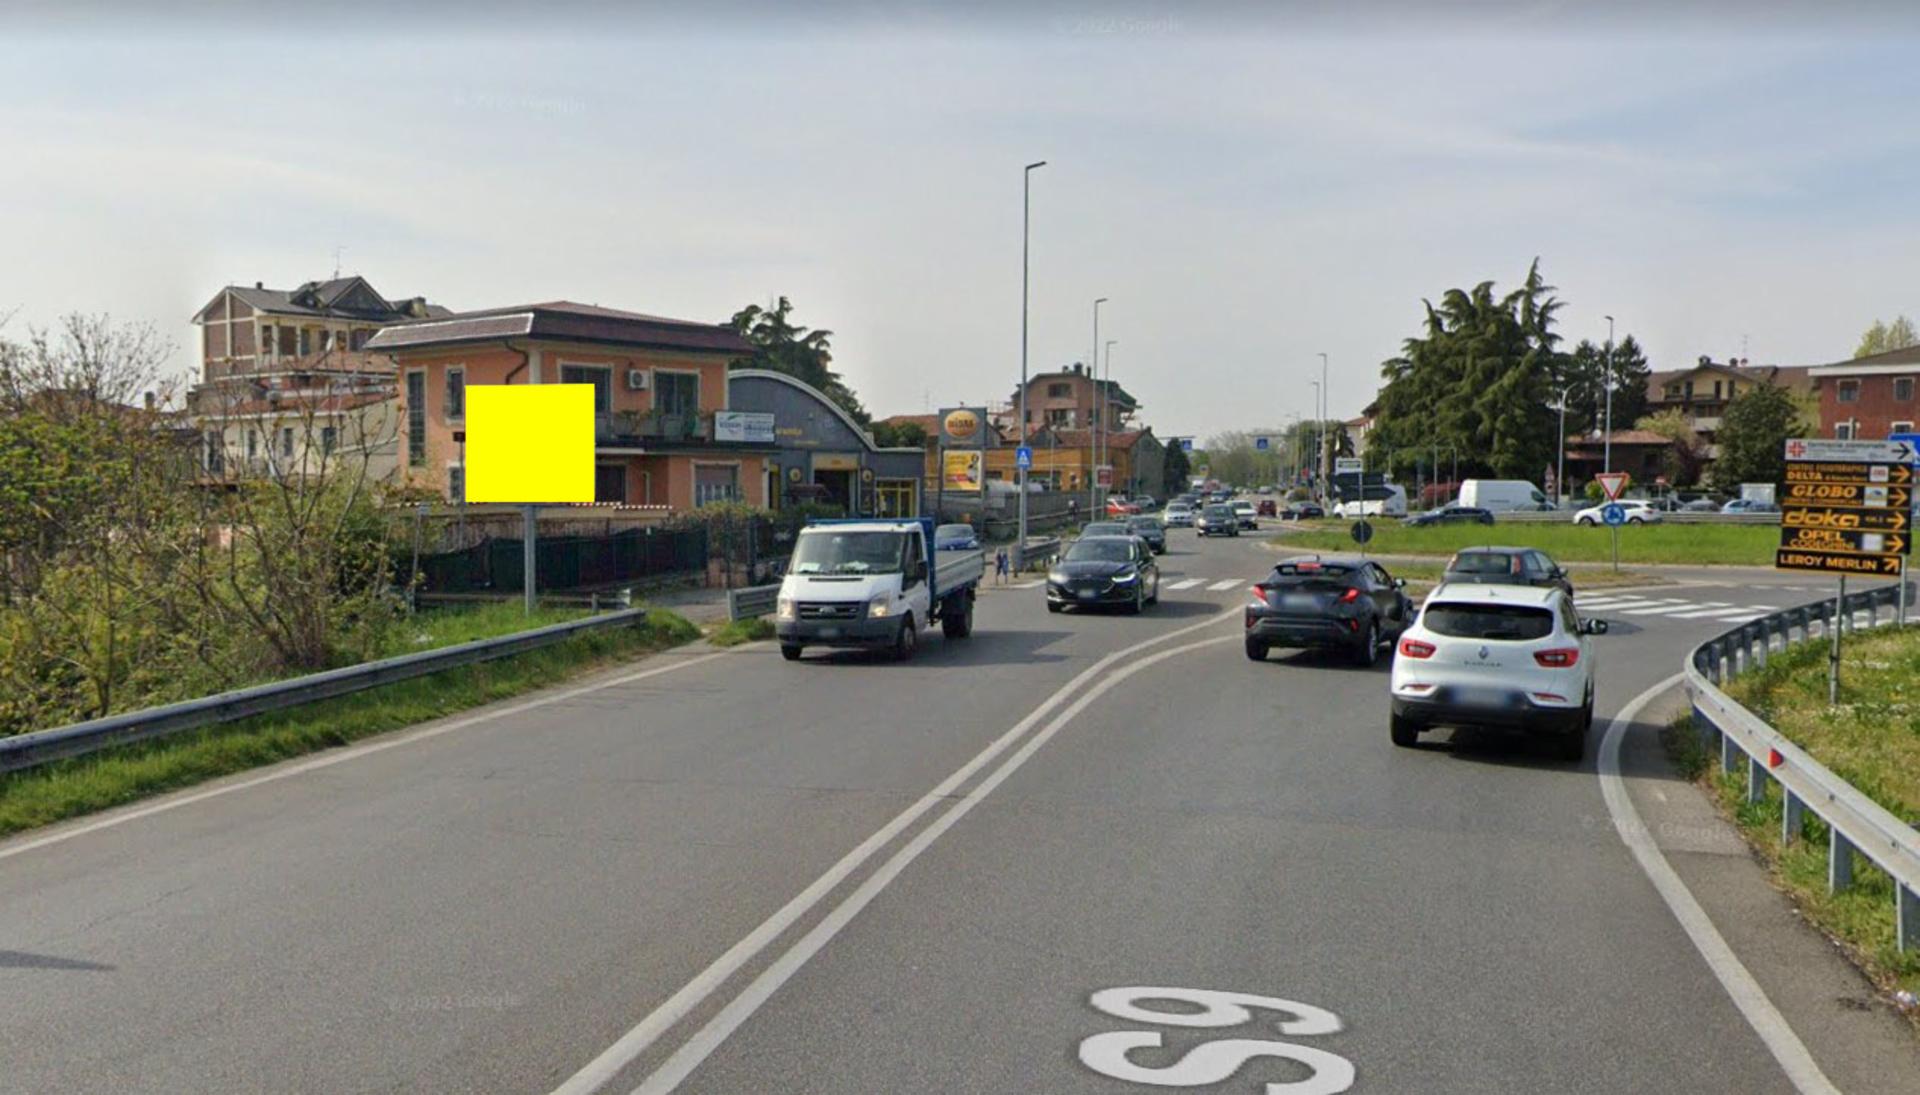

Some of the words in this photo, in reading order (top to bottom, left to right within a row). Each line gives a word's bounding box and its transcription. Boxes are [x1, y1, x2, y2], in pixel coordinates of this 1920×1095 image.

[1787, 471, 1823, 480] DELTA
[1791, 485, 1858, 498] GLOBO
[1785, 508, 1860, 527] doka
[1799, 529, 1842, 540] OPEL
[1780, 554, 1824, 566] LEROY
[1826, 557, 1878, 570] MERLIN
